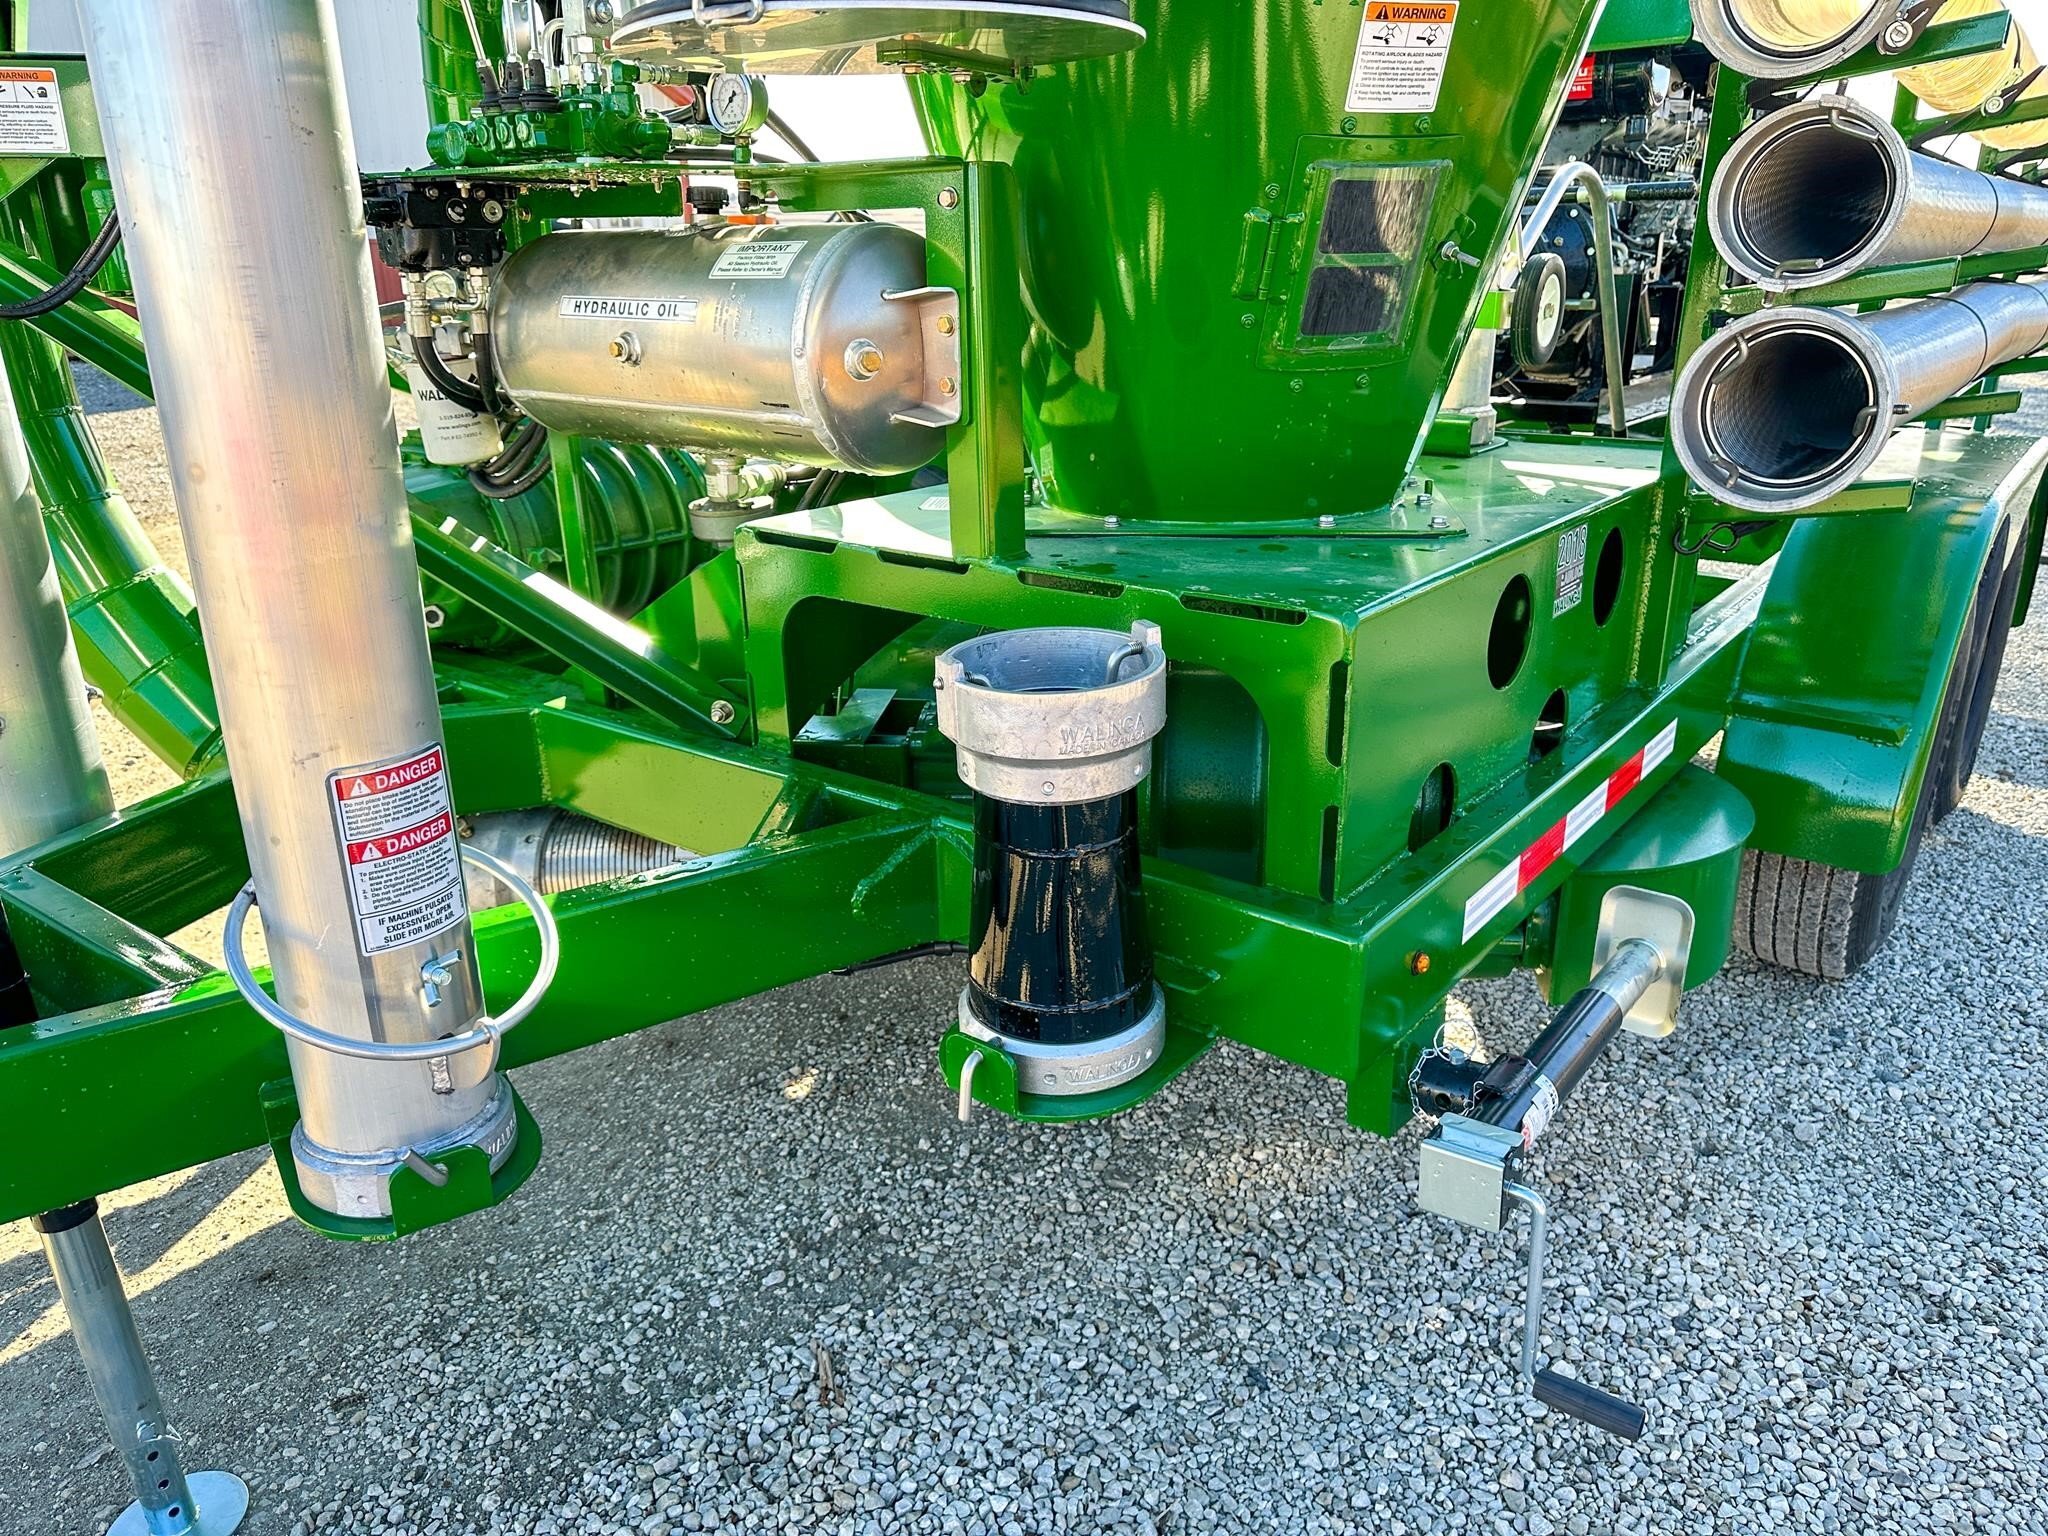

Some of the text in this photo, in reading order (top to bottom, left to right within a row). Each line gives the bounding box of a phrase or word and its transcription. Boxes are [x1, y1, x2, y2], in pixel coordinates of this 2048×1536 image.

[1392, 8, 1446, 19] WARNING
[737, 244, 791, 252] IMPORTANT
[573, 300, 680, 318] HYDRAULIC OIL
[1557, 525, 1588, 572] 2018
[1060, 713, 1145, 744] WALINGA
[375, 757, 437, 790] DANGER
[387, 818, 447, 853] DANGER
[368, 866, 390, 876] prevent
[391, 861, 411, 870] serious
[412, 856, 425, 864] injury
[374, 837, 448, 868] ELECTRO-STATIC HAZARD
[378, 917, 387, 926] IF
[388, 906, 424, 924] MACHINE
[425, 891, 453, 911] PULSATES
[436, 903, 452, 916] OPEN
[383, 910, 455, 944] SLIDE FOR MORE AIR
[1069, 1054, 1136, 1081] WALINGA
